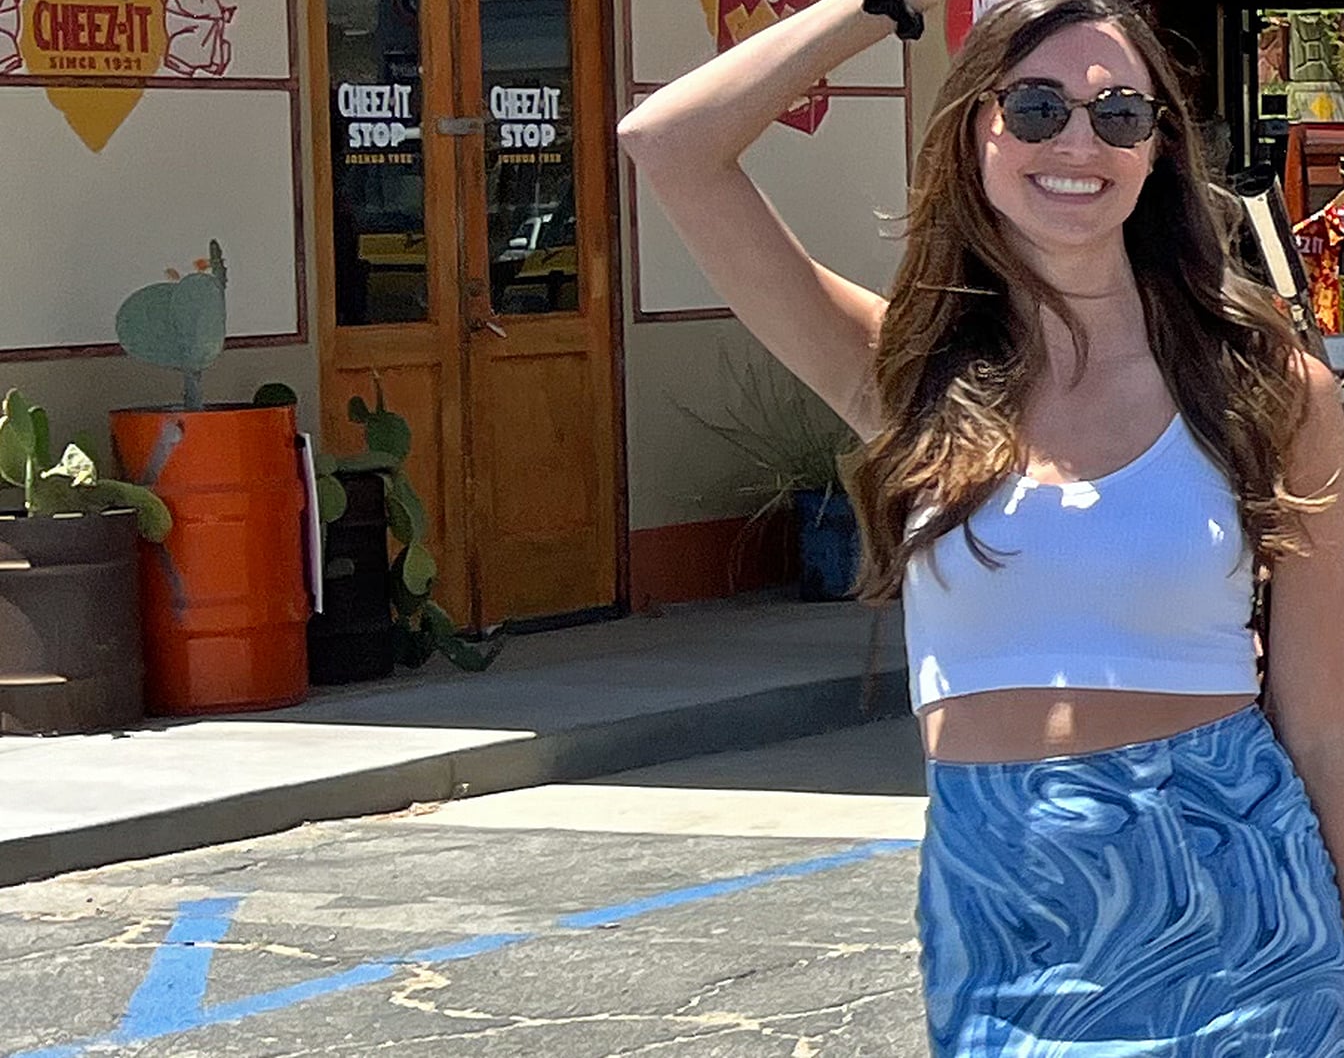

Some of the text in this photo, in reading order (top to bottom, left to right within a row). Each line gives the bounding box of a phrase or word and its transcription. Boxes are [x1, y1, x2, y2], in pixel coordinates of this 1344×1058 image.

[49, 56, 97, 70] SINCE
[348, 122, 406, 148] STOP
[500, 123, 556, 148] STOP
